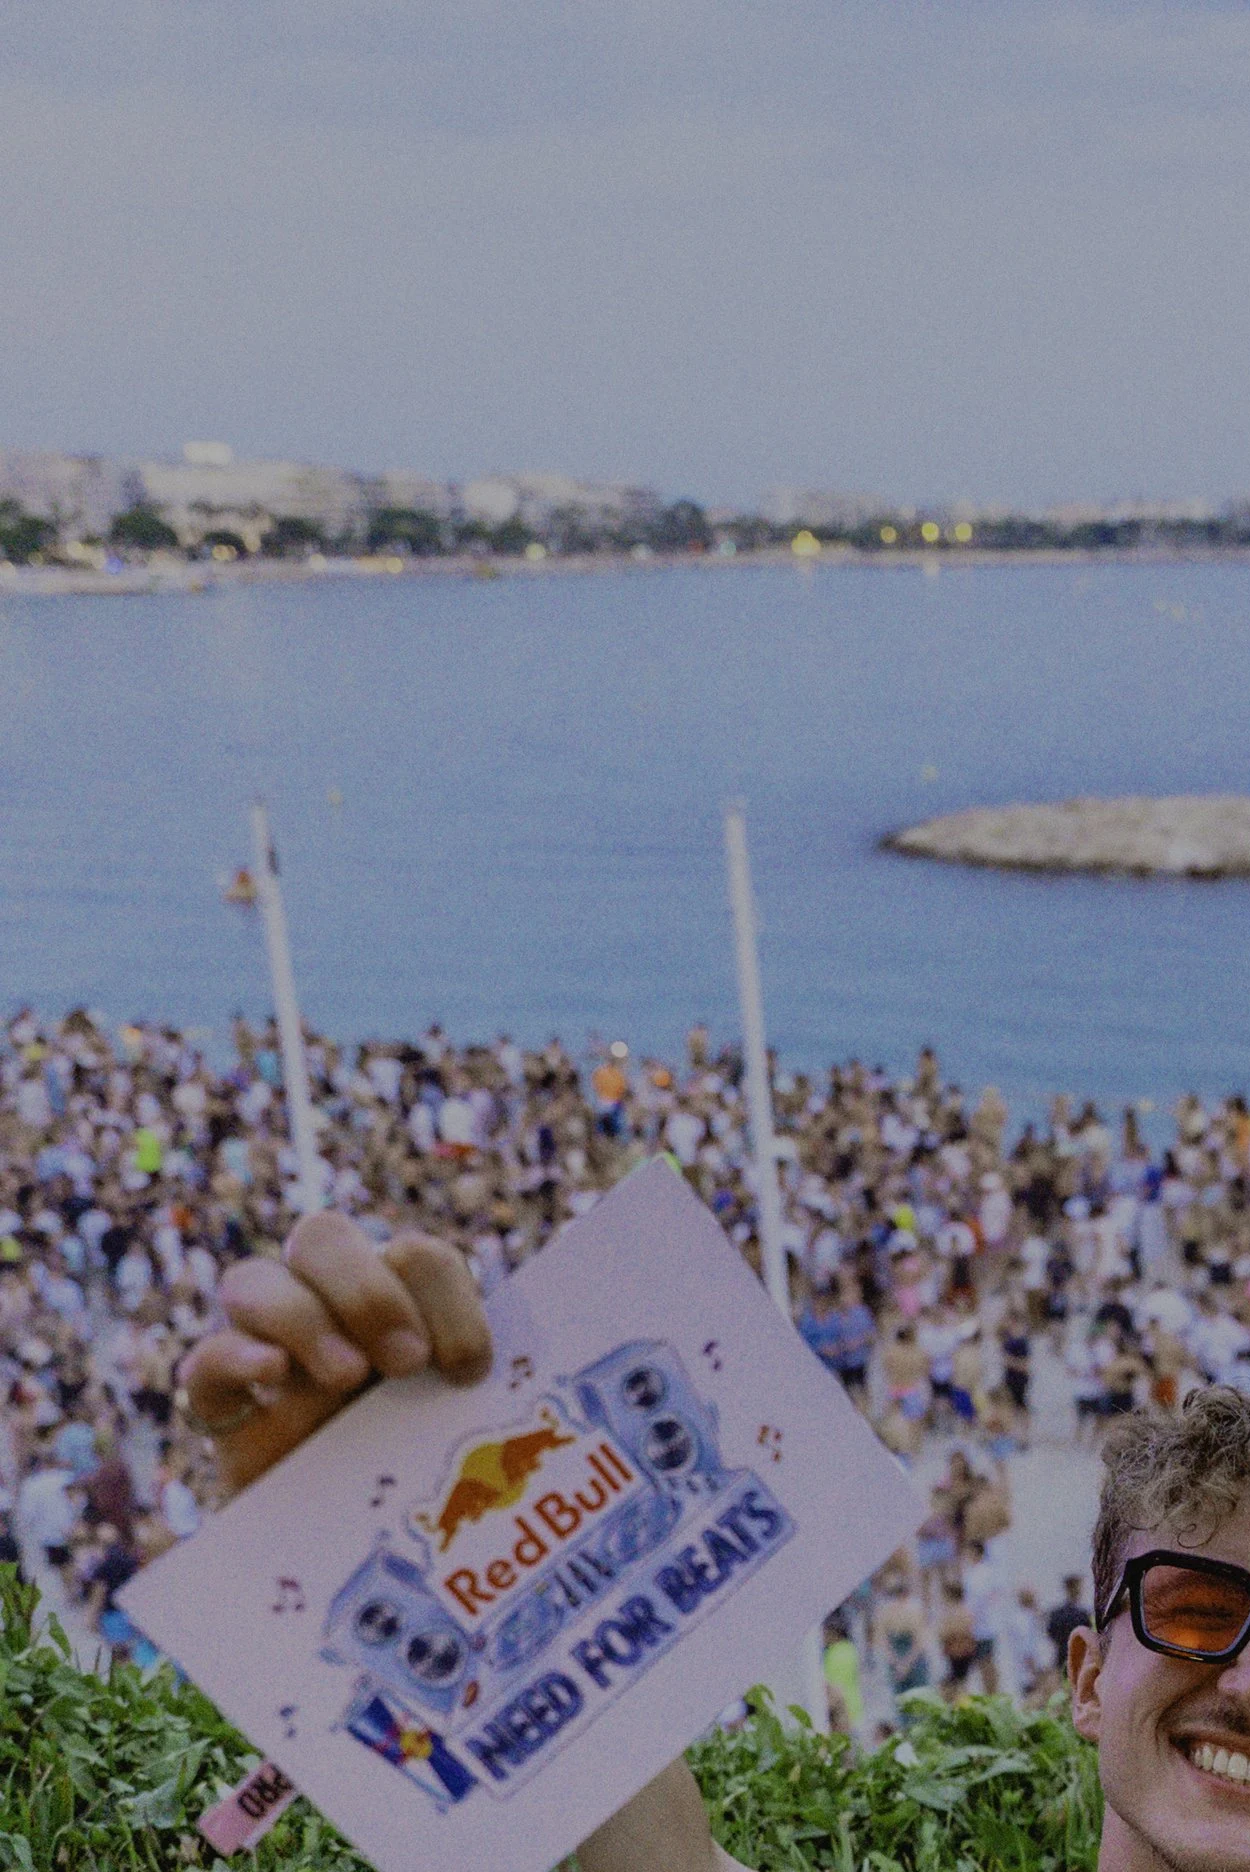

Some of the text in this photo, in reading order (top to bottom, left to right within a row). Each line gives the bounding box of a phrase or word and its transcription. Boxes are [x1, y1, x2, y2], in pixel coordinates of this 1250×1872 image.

[444, 1444, 634, 1616] Red Bull
[465, 1491, 784, 1781] NEED FOR BEATS
